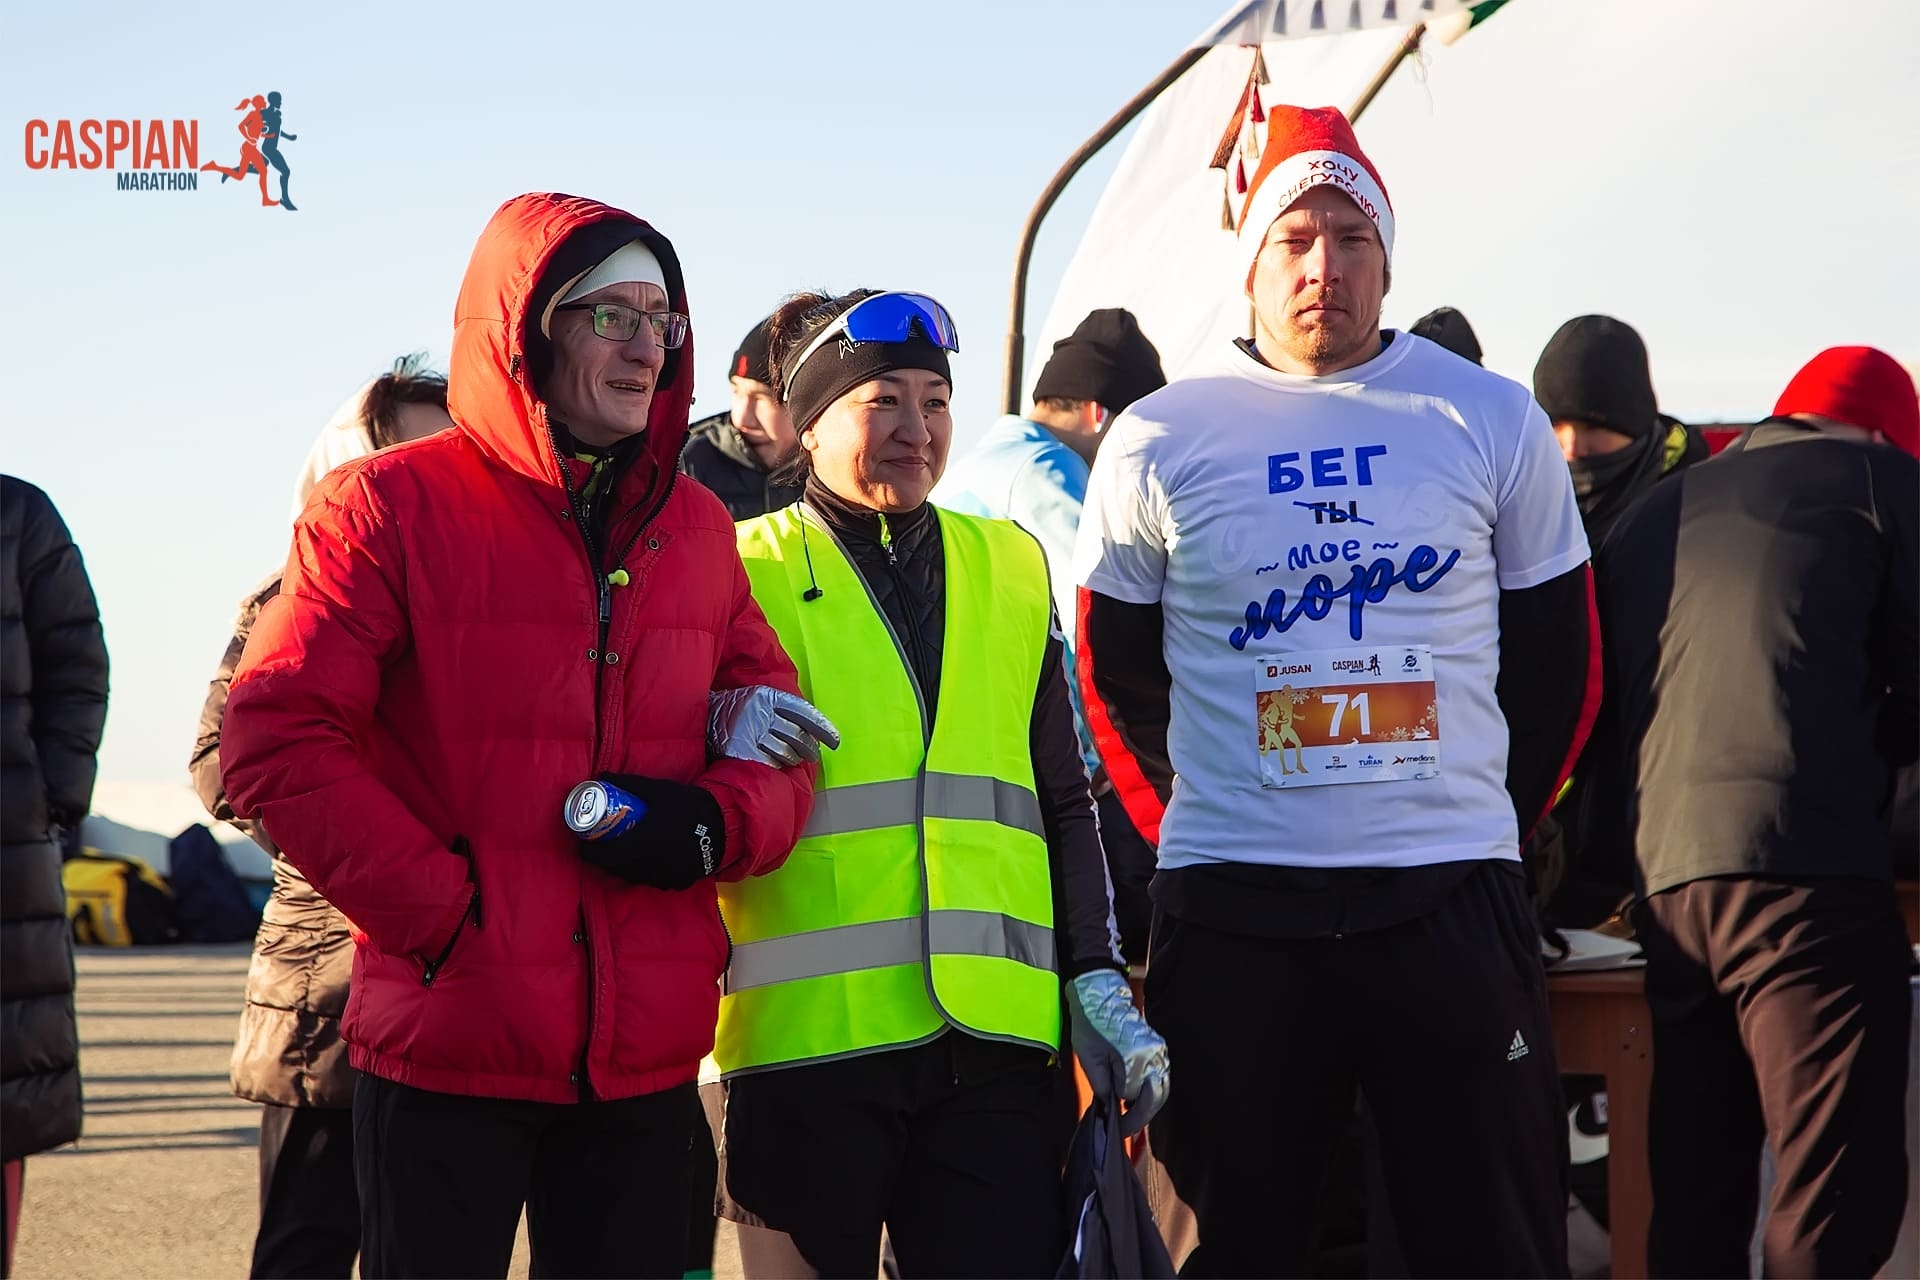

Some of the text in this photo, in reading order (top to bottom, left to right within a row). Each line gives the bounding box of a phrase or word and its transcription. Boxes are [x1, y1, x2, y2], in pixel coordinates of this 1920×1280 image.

[1308, 160, 1358, 182] ХОЧУ
[1268, 445, 1387, 494] БЕГ
[1229, 545, 1461, 650] море
[1280, 664, 1312, 675] JUSAN
[1332, 660, 1364, 671] CASPIAN
[1321, 692, 1371, 737] 71
